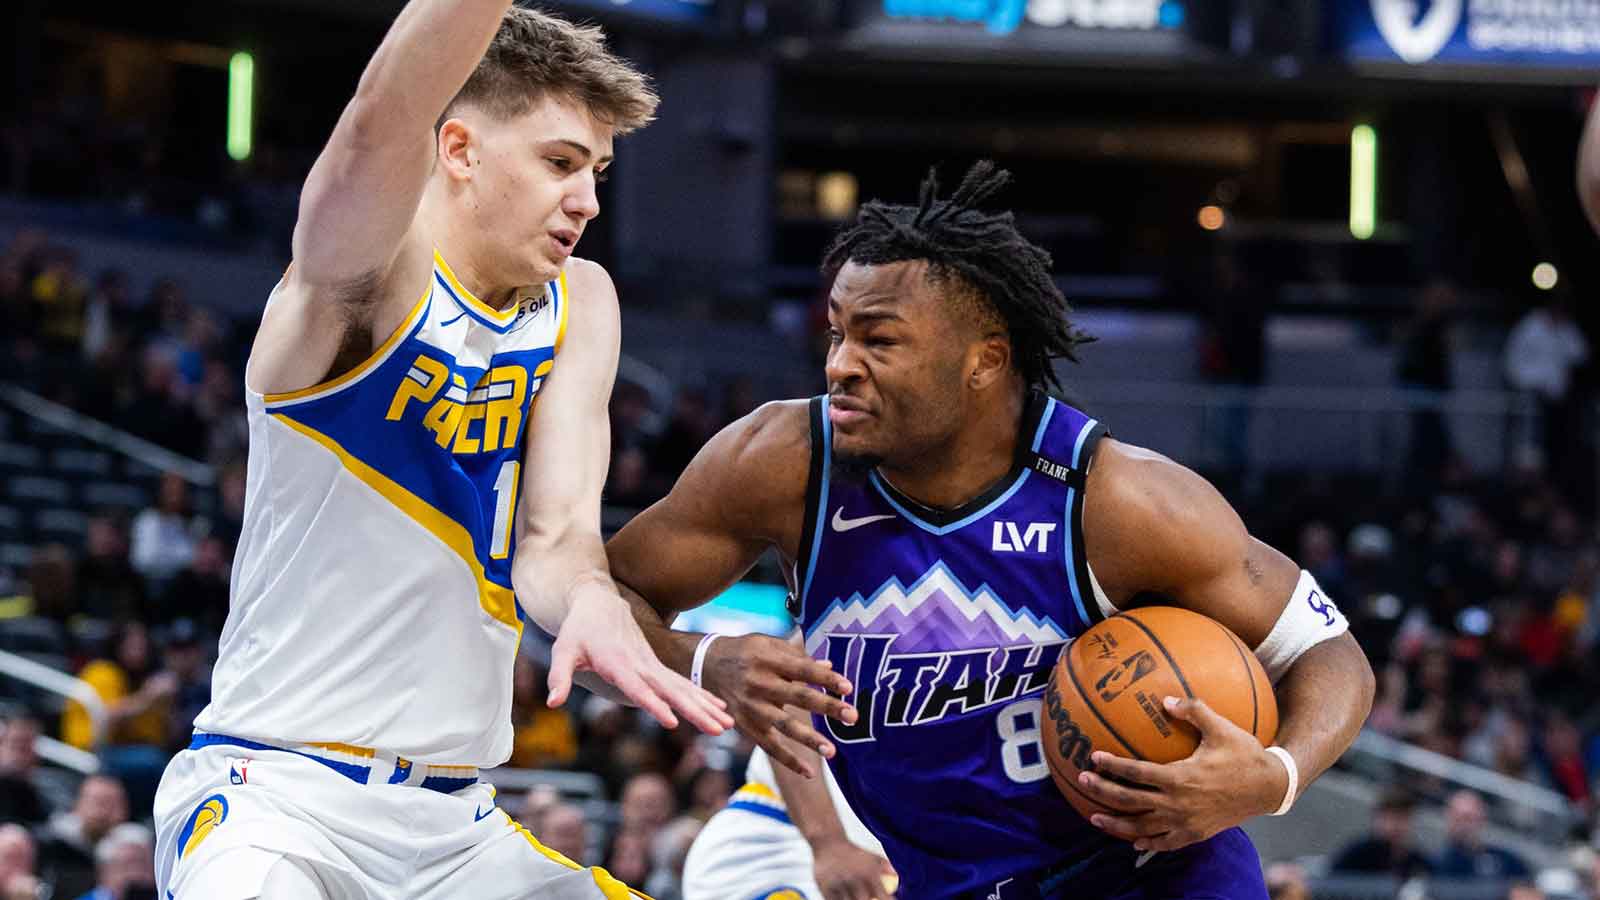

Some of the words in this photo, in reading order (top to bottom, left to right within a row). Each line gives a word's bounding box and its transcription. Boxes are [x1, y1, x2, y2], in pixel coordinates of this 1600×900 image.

[529, 295, 549, 313] OIL
[1035, 457, 1070, 482] FRANK
[992, 521, 1057, 553] LVT
[823, 633, 1077, 744] UTAH
[996, 698, 1051, 784] 8
